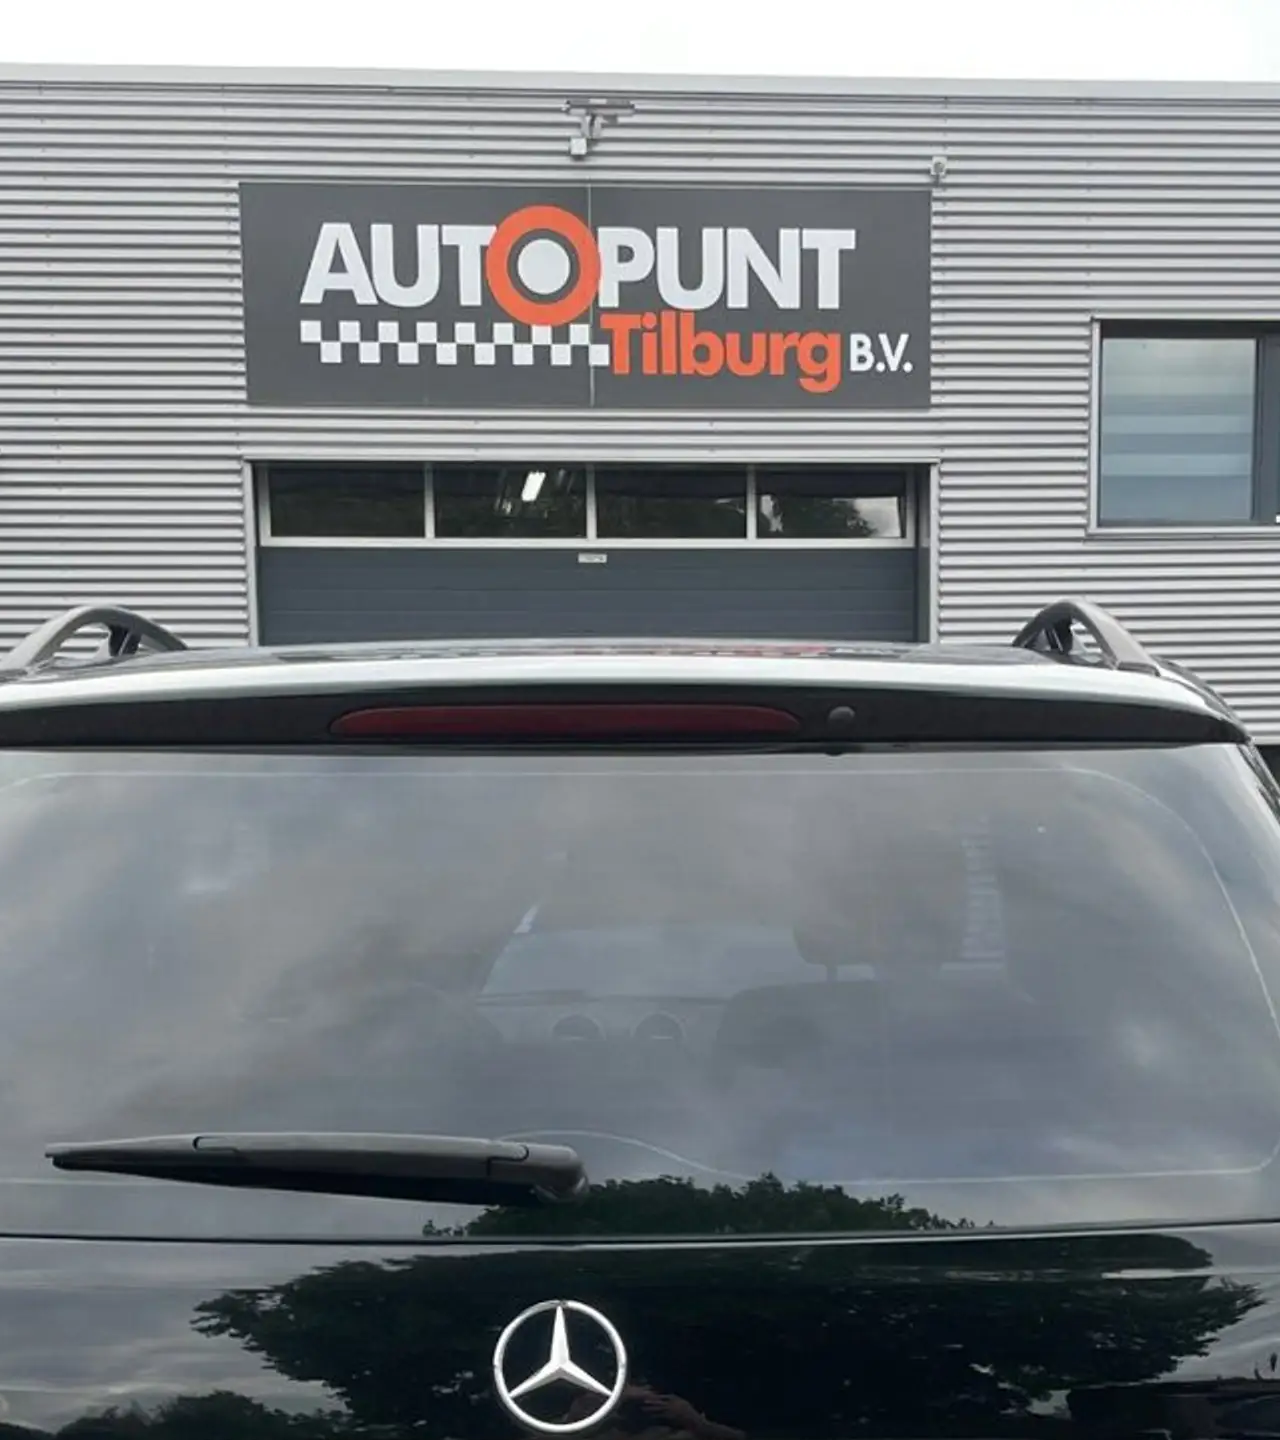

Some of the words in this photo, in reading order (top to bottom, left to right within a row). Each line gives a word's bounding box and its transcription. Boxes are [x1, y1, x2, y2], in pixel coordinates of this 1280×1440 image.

[300, 206, 856, 326] AUTOPUNT
[600, 309, 842, 393] Tilburg
[849, 333, 913, 373] B.V.
